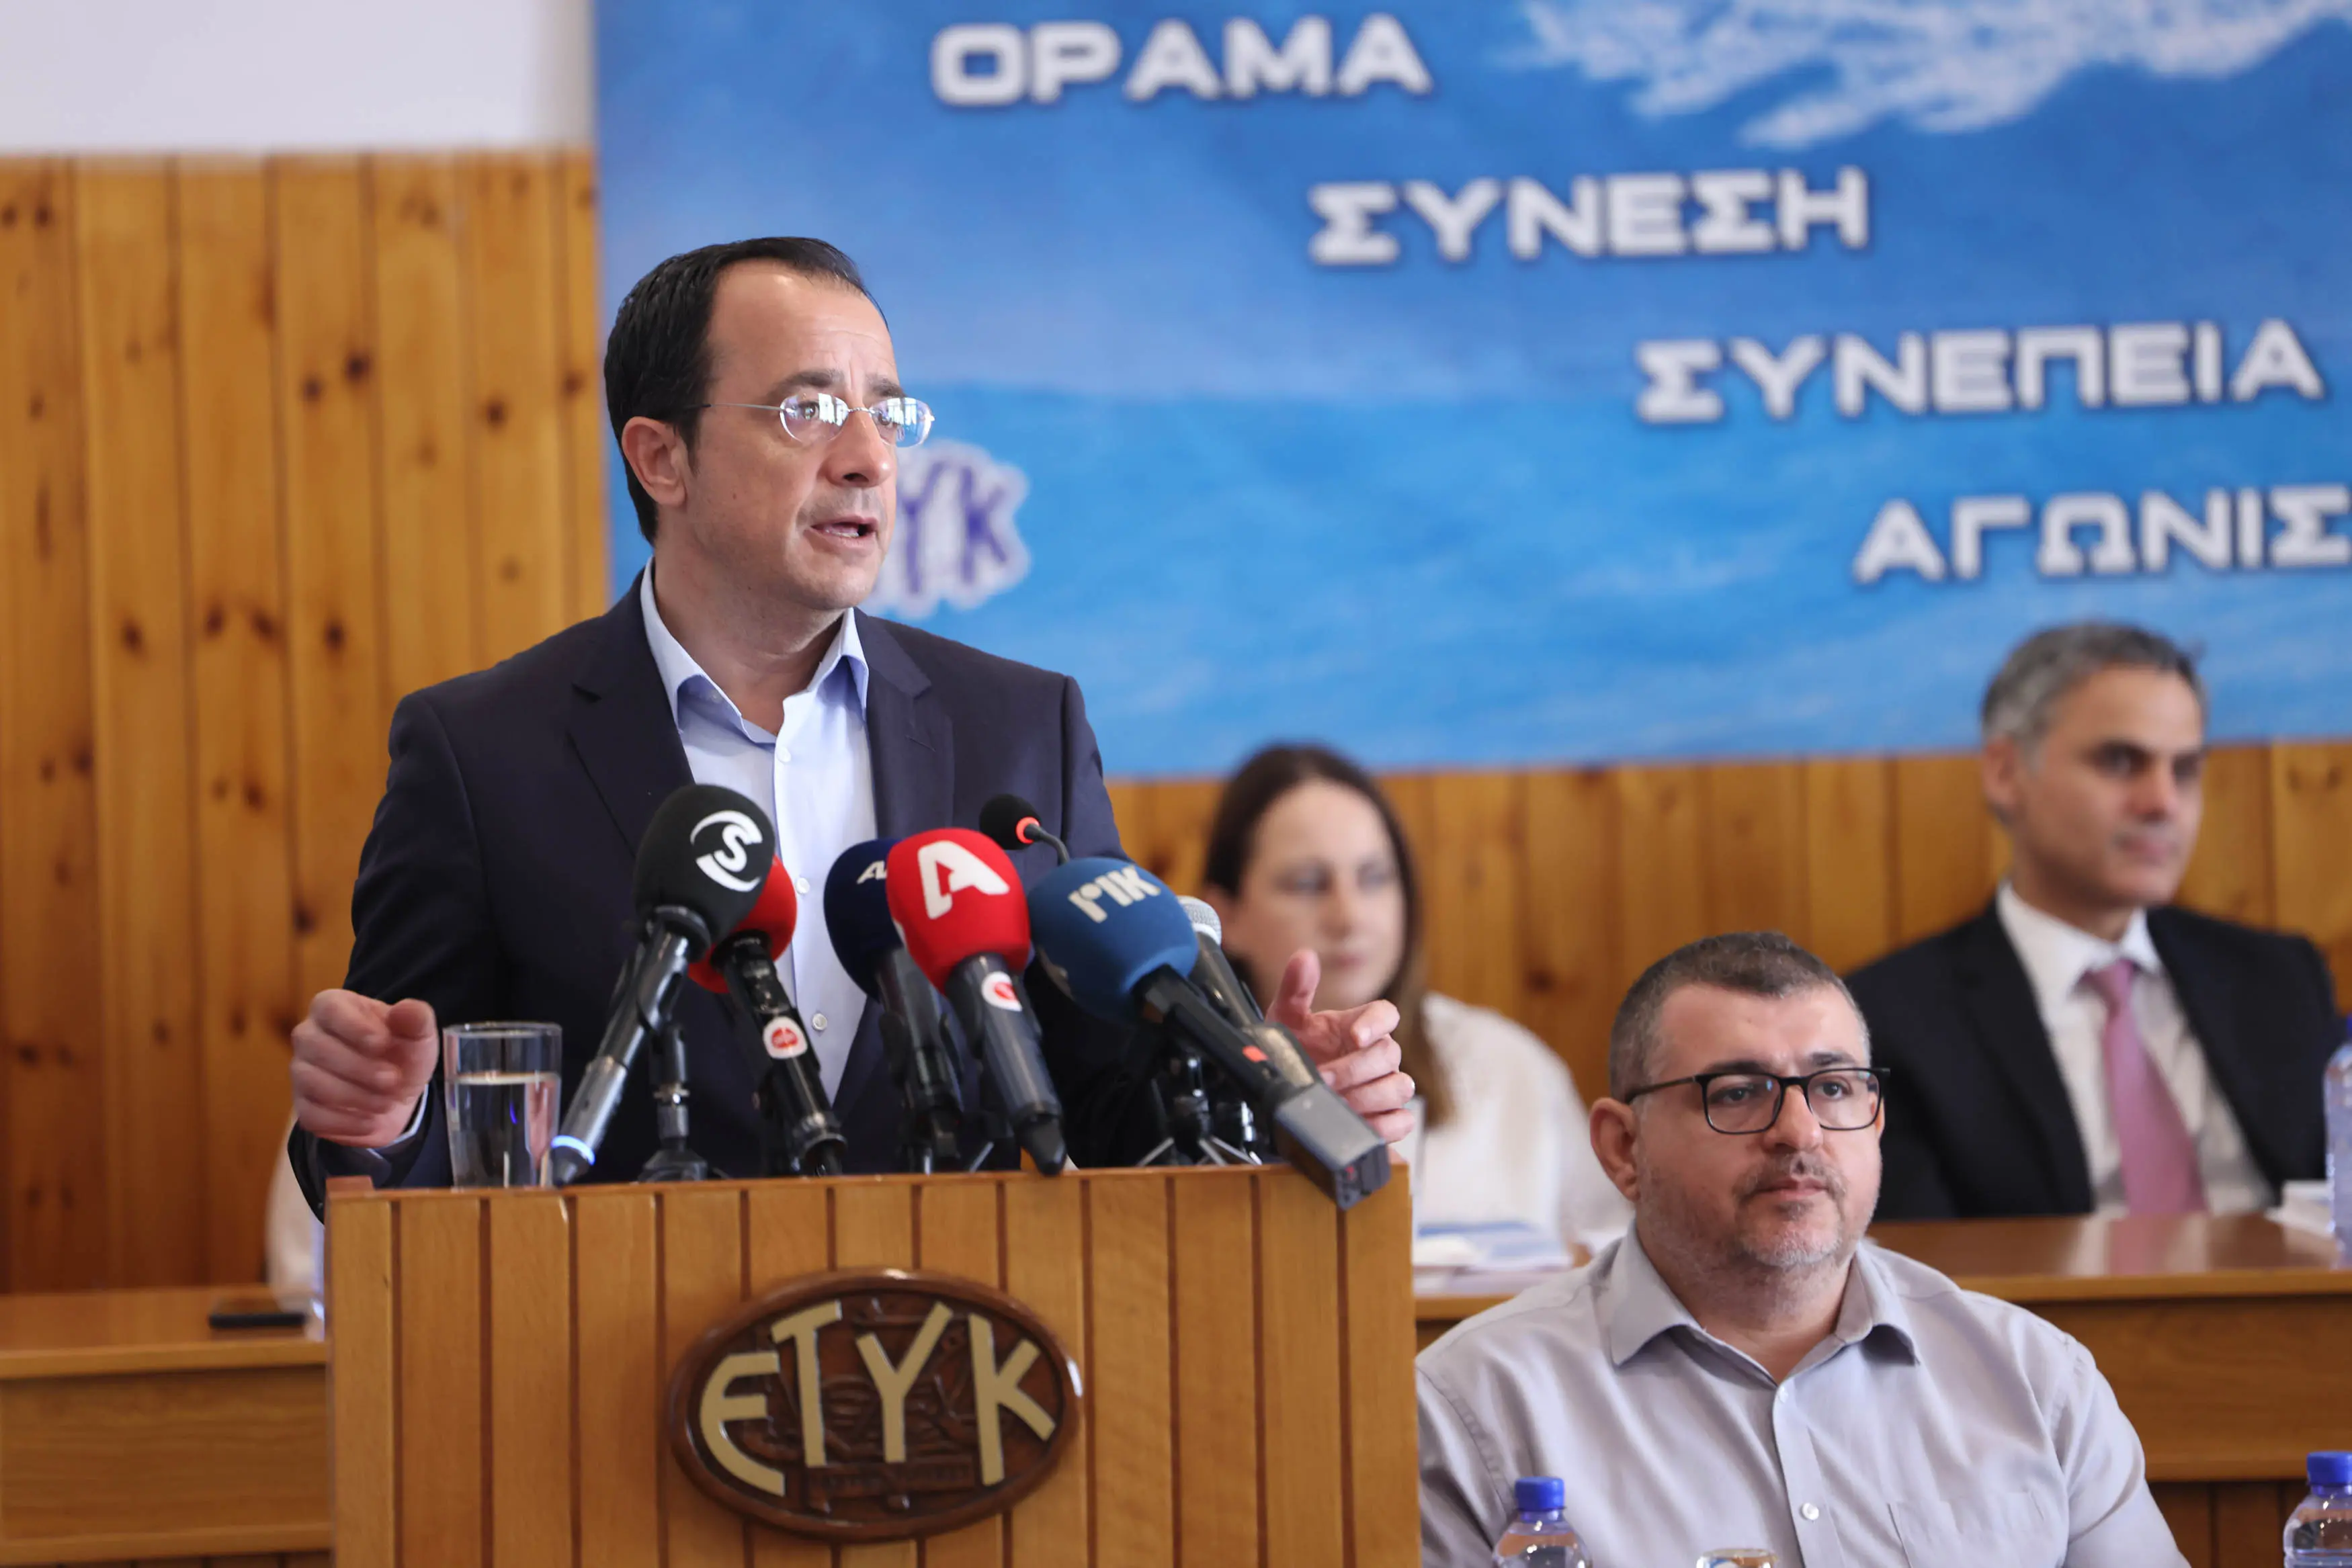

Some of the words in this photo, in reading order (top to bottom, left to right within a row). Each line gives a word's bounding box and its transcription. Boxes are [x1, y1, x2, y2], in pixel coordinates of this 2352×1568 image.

[931, 13, 1433, 105] ΟΡΑΜΑ
[1308, 166, 1869, 264] ΣΥΝΕΣΗ
[1636, 318, 2326, 423] ΣΥΝΕΠΕΙΑ
[1853, 485, 2351, 585] ΑΓΩΝΙΣ
[700, 1300, 1056, 1497] ΕΤΥΚ
